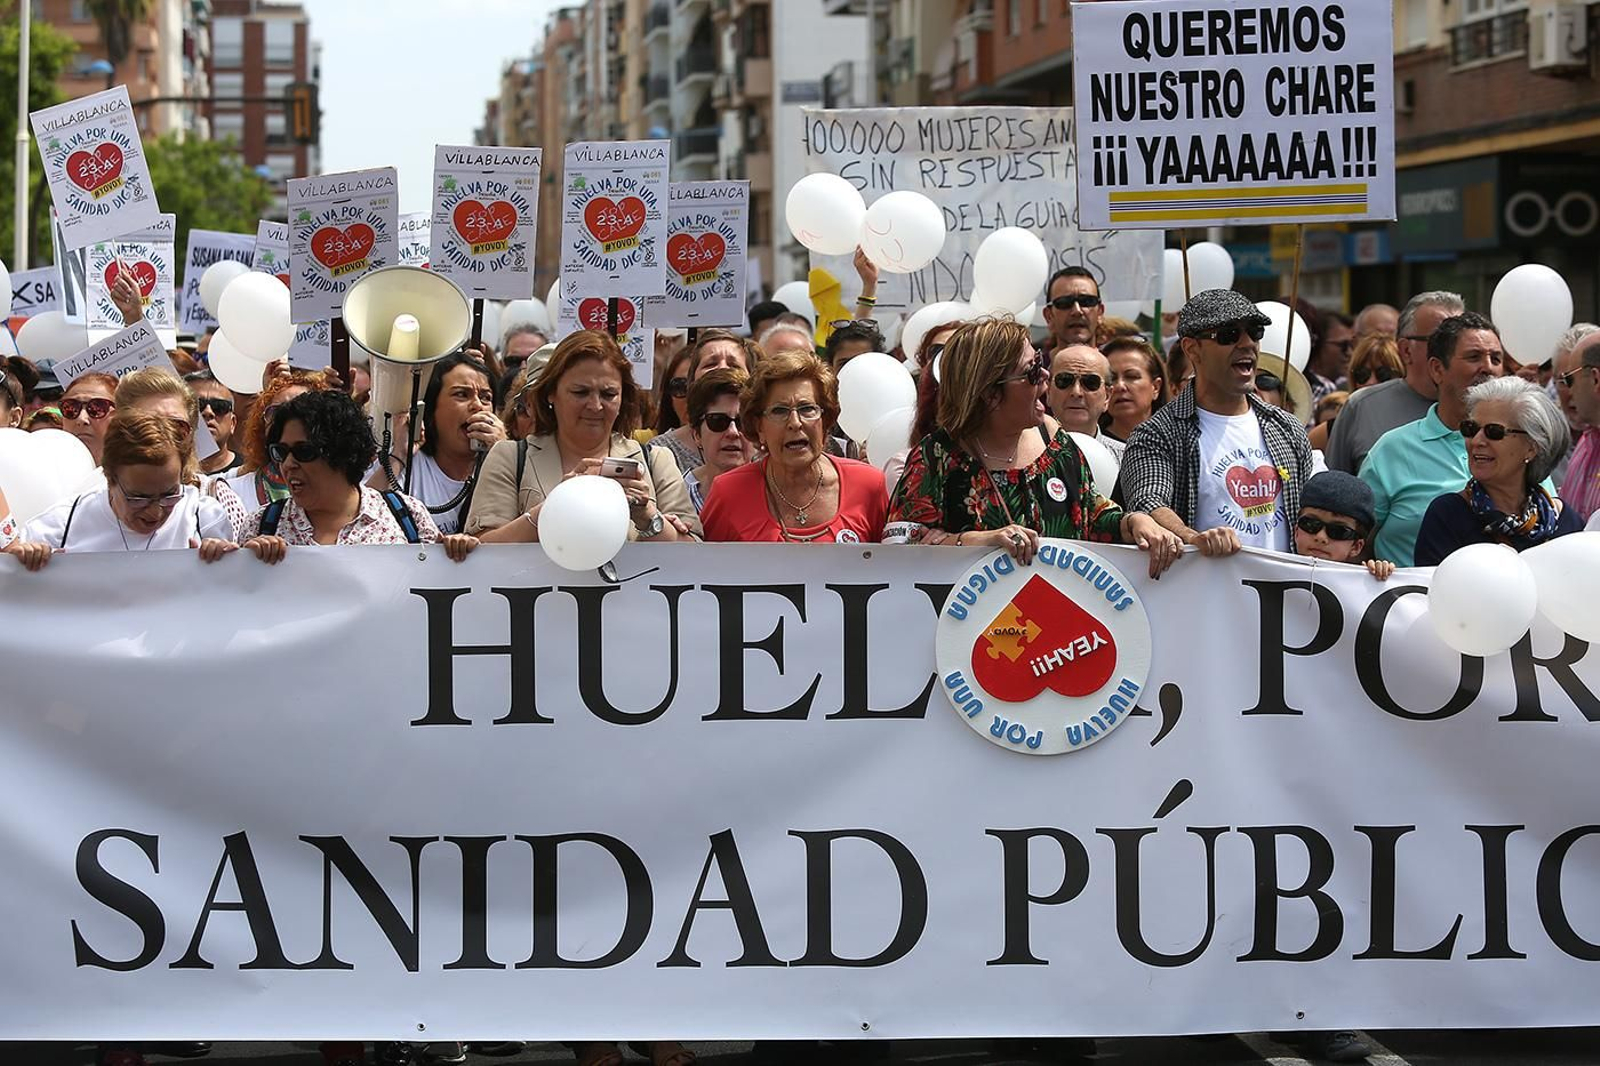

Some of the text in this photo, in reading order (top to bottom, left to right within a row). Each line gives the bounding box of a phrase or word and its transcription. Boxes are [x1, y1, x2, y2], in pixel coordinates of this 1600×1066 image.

[1122, 4, 1346, 62] QUEREMOS
[1090, 63, 1376, 122] NUESTRO CHARE
[53, 132, 84, 169] HUELVA
[85, 127, 107, 140] POR
[801, 115, 906, 156] 100.000
[917, 115, 1037, 153] MUJERES
[919, 148, 1076, 190] RESPUESTA
[94, 178, 122, 199] #YOVOY
[441, 182, 482, 210] HUELVA
[487, 181, 508, 196] POR
[572, 178, 611, 209] HUELVA
[616, 177, 638, 192] POR
[669, 187, 744, 200] ILLABLANCA
[65, 193, 110, 216] SANIDAD
[298, 209, 338, 241] HUELVA
[342, 207, 364, 219] POR
[667, 216, 692, 236] ELVA
[696, 214, 716, 228] POR
[130, 243, 147, 257] POR
[442, 240, 485, 273] SANIDAD
[474, 241, 506, 254] #YOVOY
[574, 239, 617, 271] SANIDAD
[605, 237, 637, 253] #YOVOY
[302, 268, 346, 293] SANIDAD
[334, 260, 365, 276] #YOVOY
[686, 271, 716, 285] #YOVOY
[666, 280, 697, 302] NIDAD
[1212, 448, 1245, 478] HUELVA
[1231, 479, 1277, 498] Yeah!!
[1217, 505, 1260, 535] SANIDAD
[946, 545, 1134, 621] SANIDAD DIGNA
[1029, 630, 1108, 677] YEAH!!
[944, 670, 1140, 750] HUELVA POR UNA
[70, 827, 929, 972] SANIDAD
